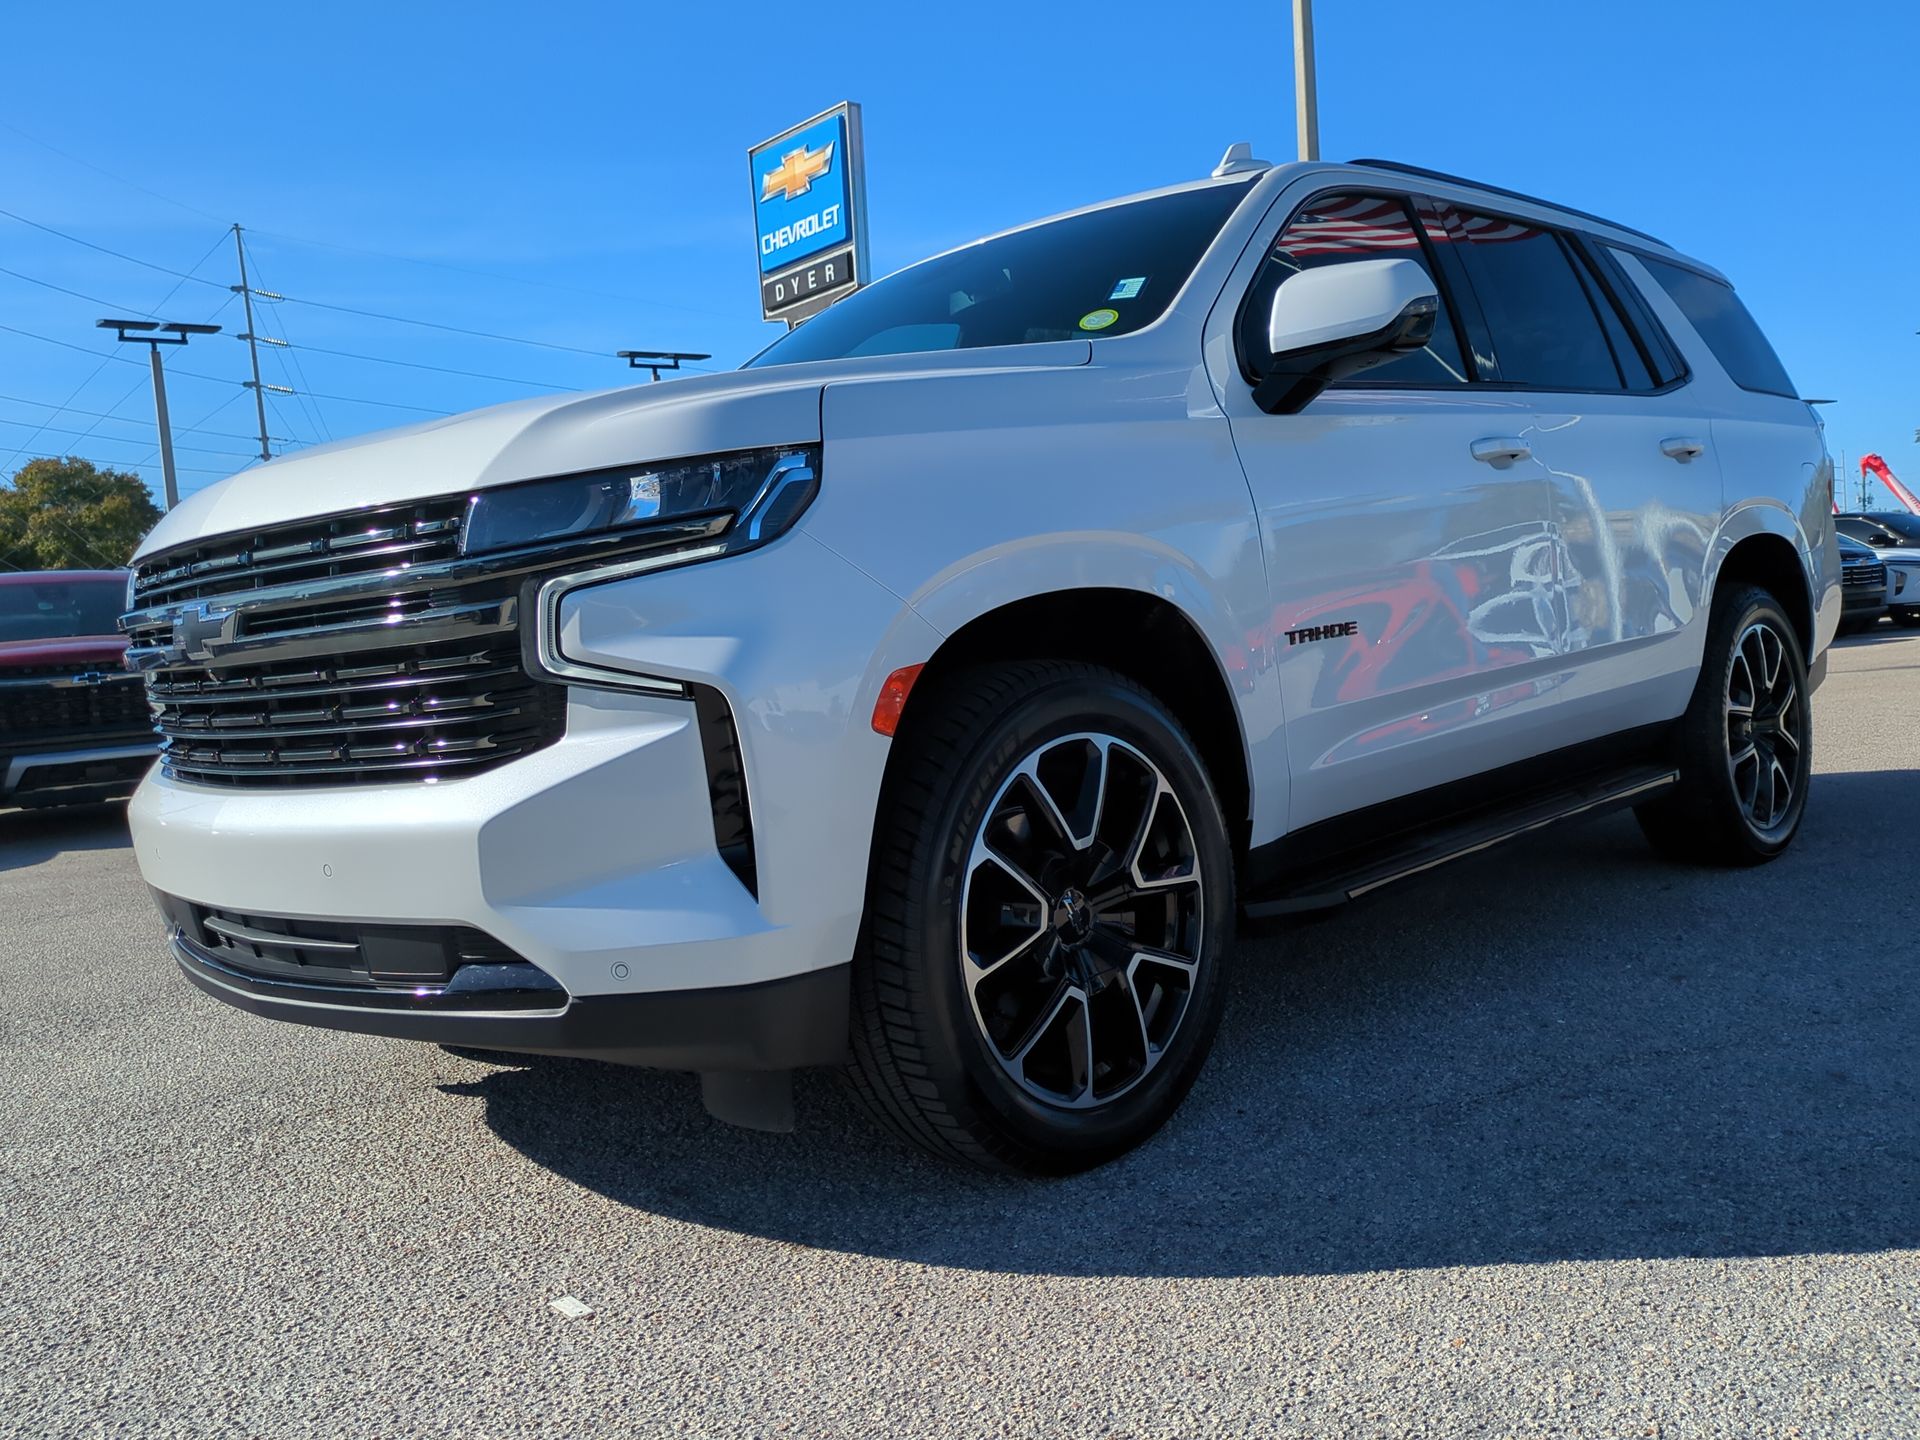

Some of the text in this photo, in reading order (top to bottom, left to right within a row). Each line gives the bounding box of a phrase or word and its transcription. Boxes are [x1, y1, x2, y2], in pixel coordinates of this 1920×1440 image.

[762, 203, 840, 255] CHEVROLET
[775, 263, 835, 302] DYER
[1284, 621, 1358, 646] TAHOE
[950, 730, 1018, 865] MICHELIN
